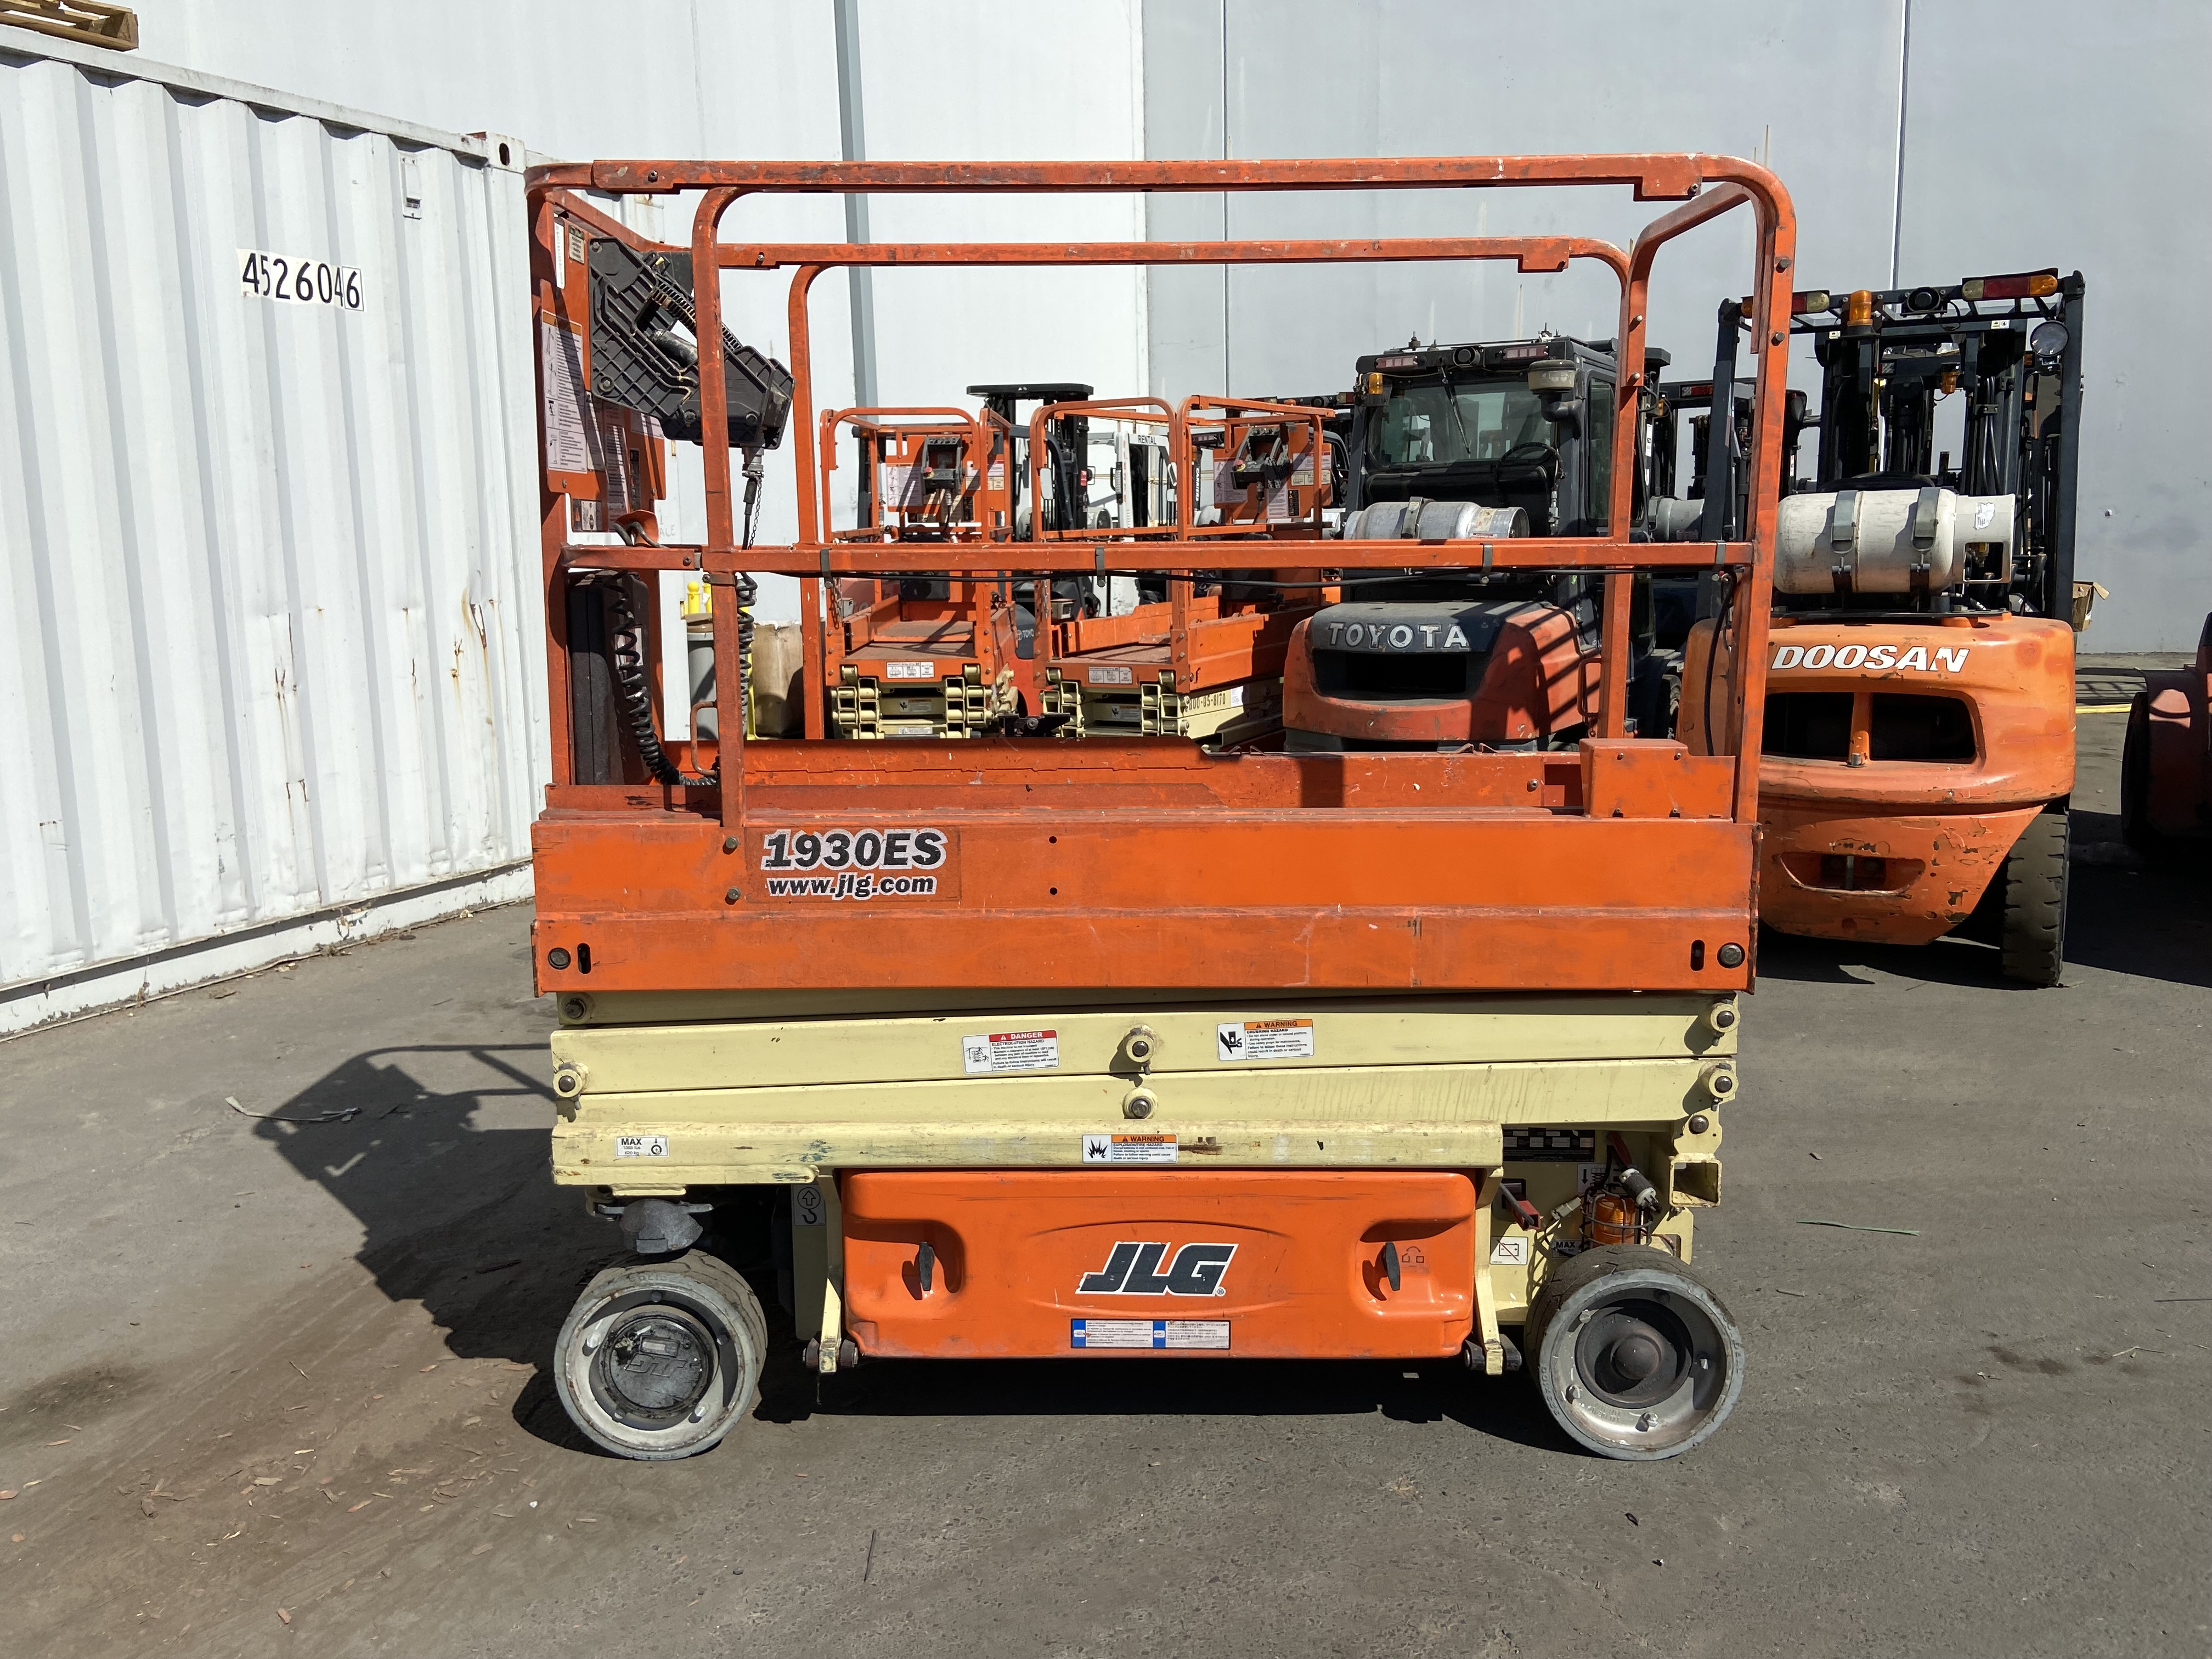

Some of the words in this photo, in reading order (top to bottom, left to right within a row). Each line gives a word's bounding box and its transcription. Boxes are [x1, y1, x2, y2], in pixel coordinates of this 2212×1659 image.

[242, 252, 360, 308] 4526046
[1138, 435, 1156, 444] RENTAL
[1329, 623, 1470, 648] TOYOTA
[1770, 644, 1970, 673] DOOSAN
[763, 830, 946, 869] 1930ES
[768, 873, 935, 899] www.jlg.com
[1011, 1031, 1043, 1040] DANGER
[1075, 1242, 1239, 1296] JLG
